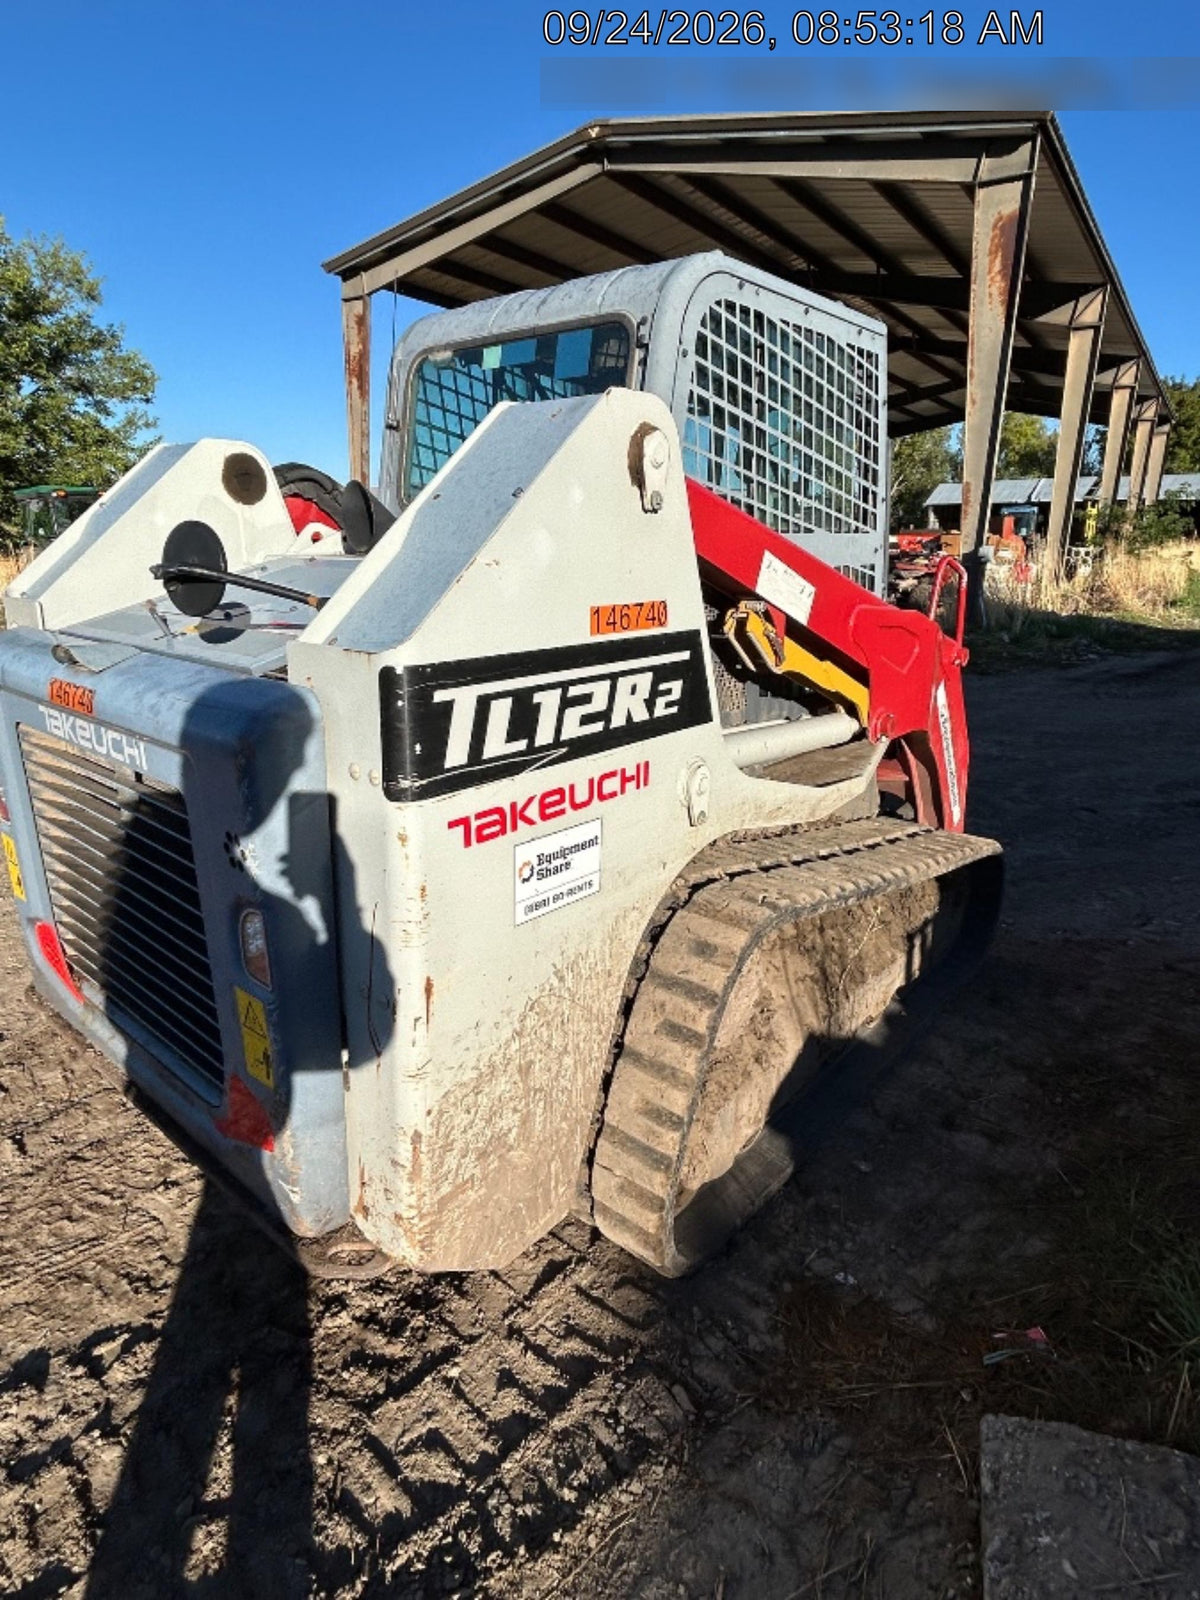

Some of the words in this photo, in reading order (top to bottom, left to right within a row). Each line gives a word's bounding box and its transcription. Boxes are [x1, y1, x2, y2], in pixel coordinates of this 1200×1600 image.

[593, 600, 668, 634] 146740
[432, 650, 691, 770] TL12R2
[38, 703, 149, 771] TAKEUCHI
[447, 760, 651, 849] TAKEUCHI
[536, 834, 599, 865] Equipment
[536, 861, 572, 881] Share
